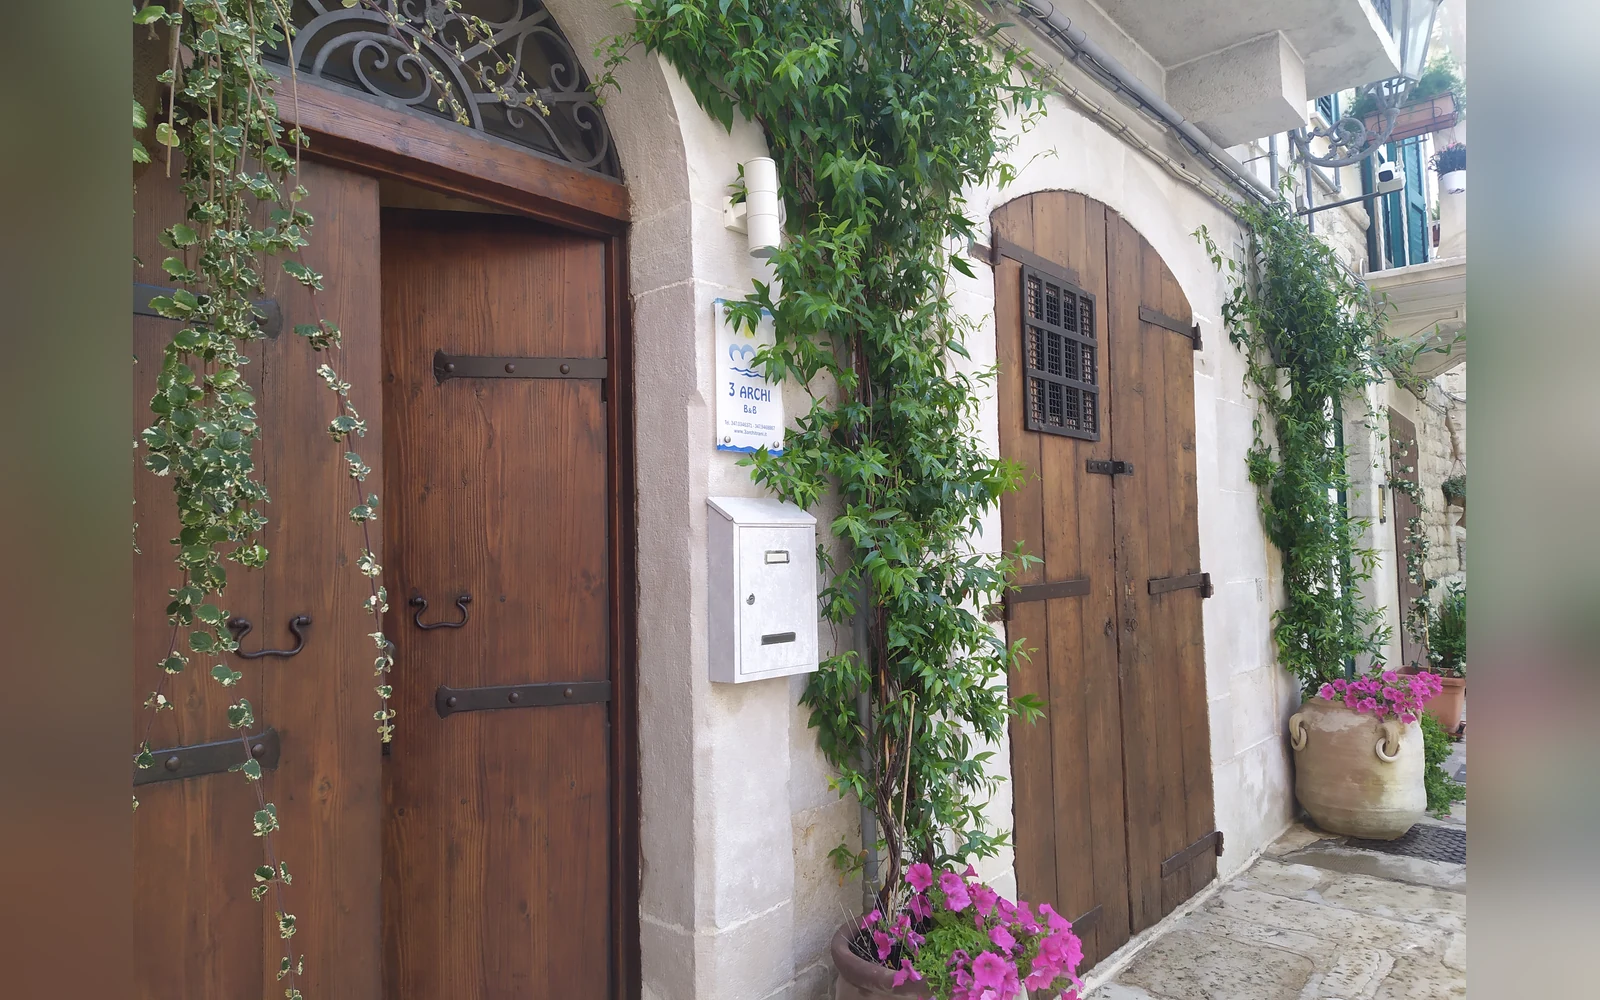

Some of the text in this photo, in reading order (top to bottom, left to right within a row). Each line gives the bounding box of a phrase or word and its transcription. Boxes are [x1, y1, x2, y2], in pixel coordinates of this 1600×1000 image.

[728, 381, 771, 402] 3 ARCHI
[743, 404, 757, 414] B&B
